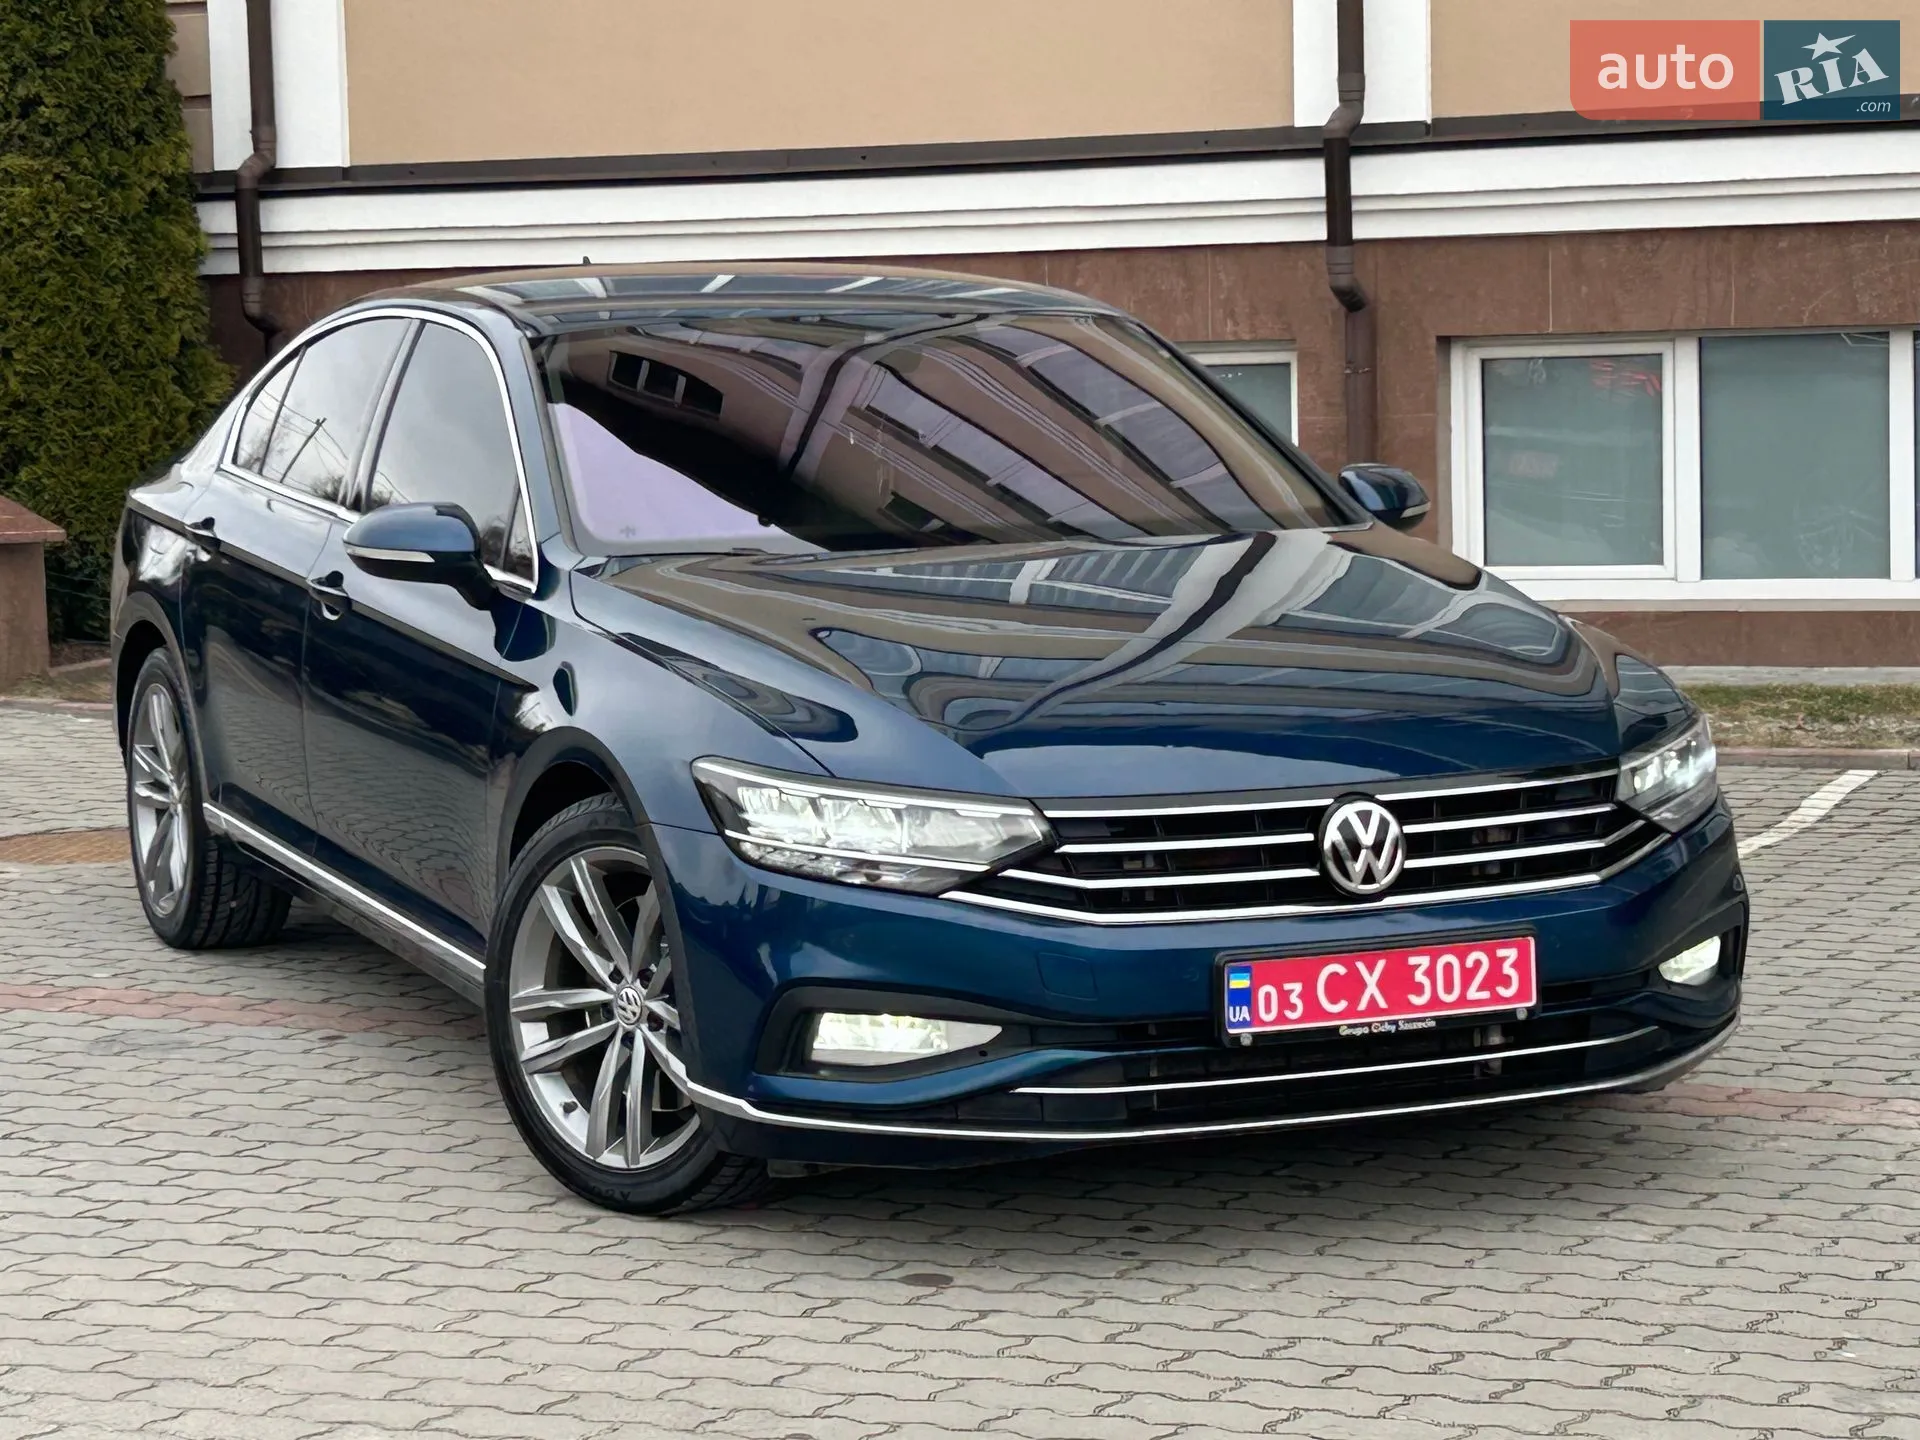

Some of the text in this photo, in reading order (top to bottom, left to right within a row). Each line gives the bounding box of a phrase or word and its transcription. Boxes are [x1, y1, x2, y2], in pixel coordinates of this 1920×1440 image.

[1257, 947, 1520, 1022] 03 CX 3023
[1229, 1006, 1250, 1022] UA
